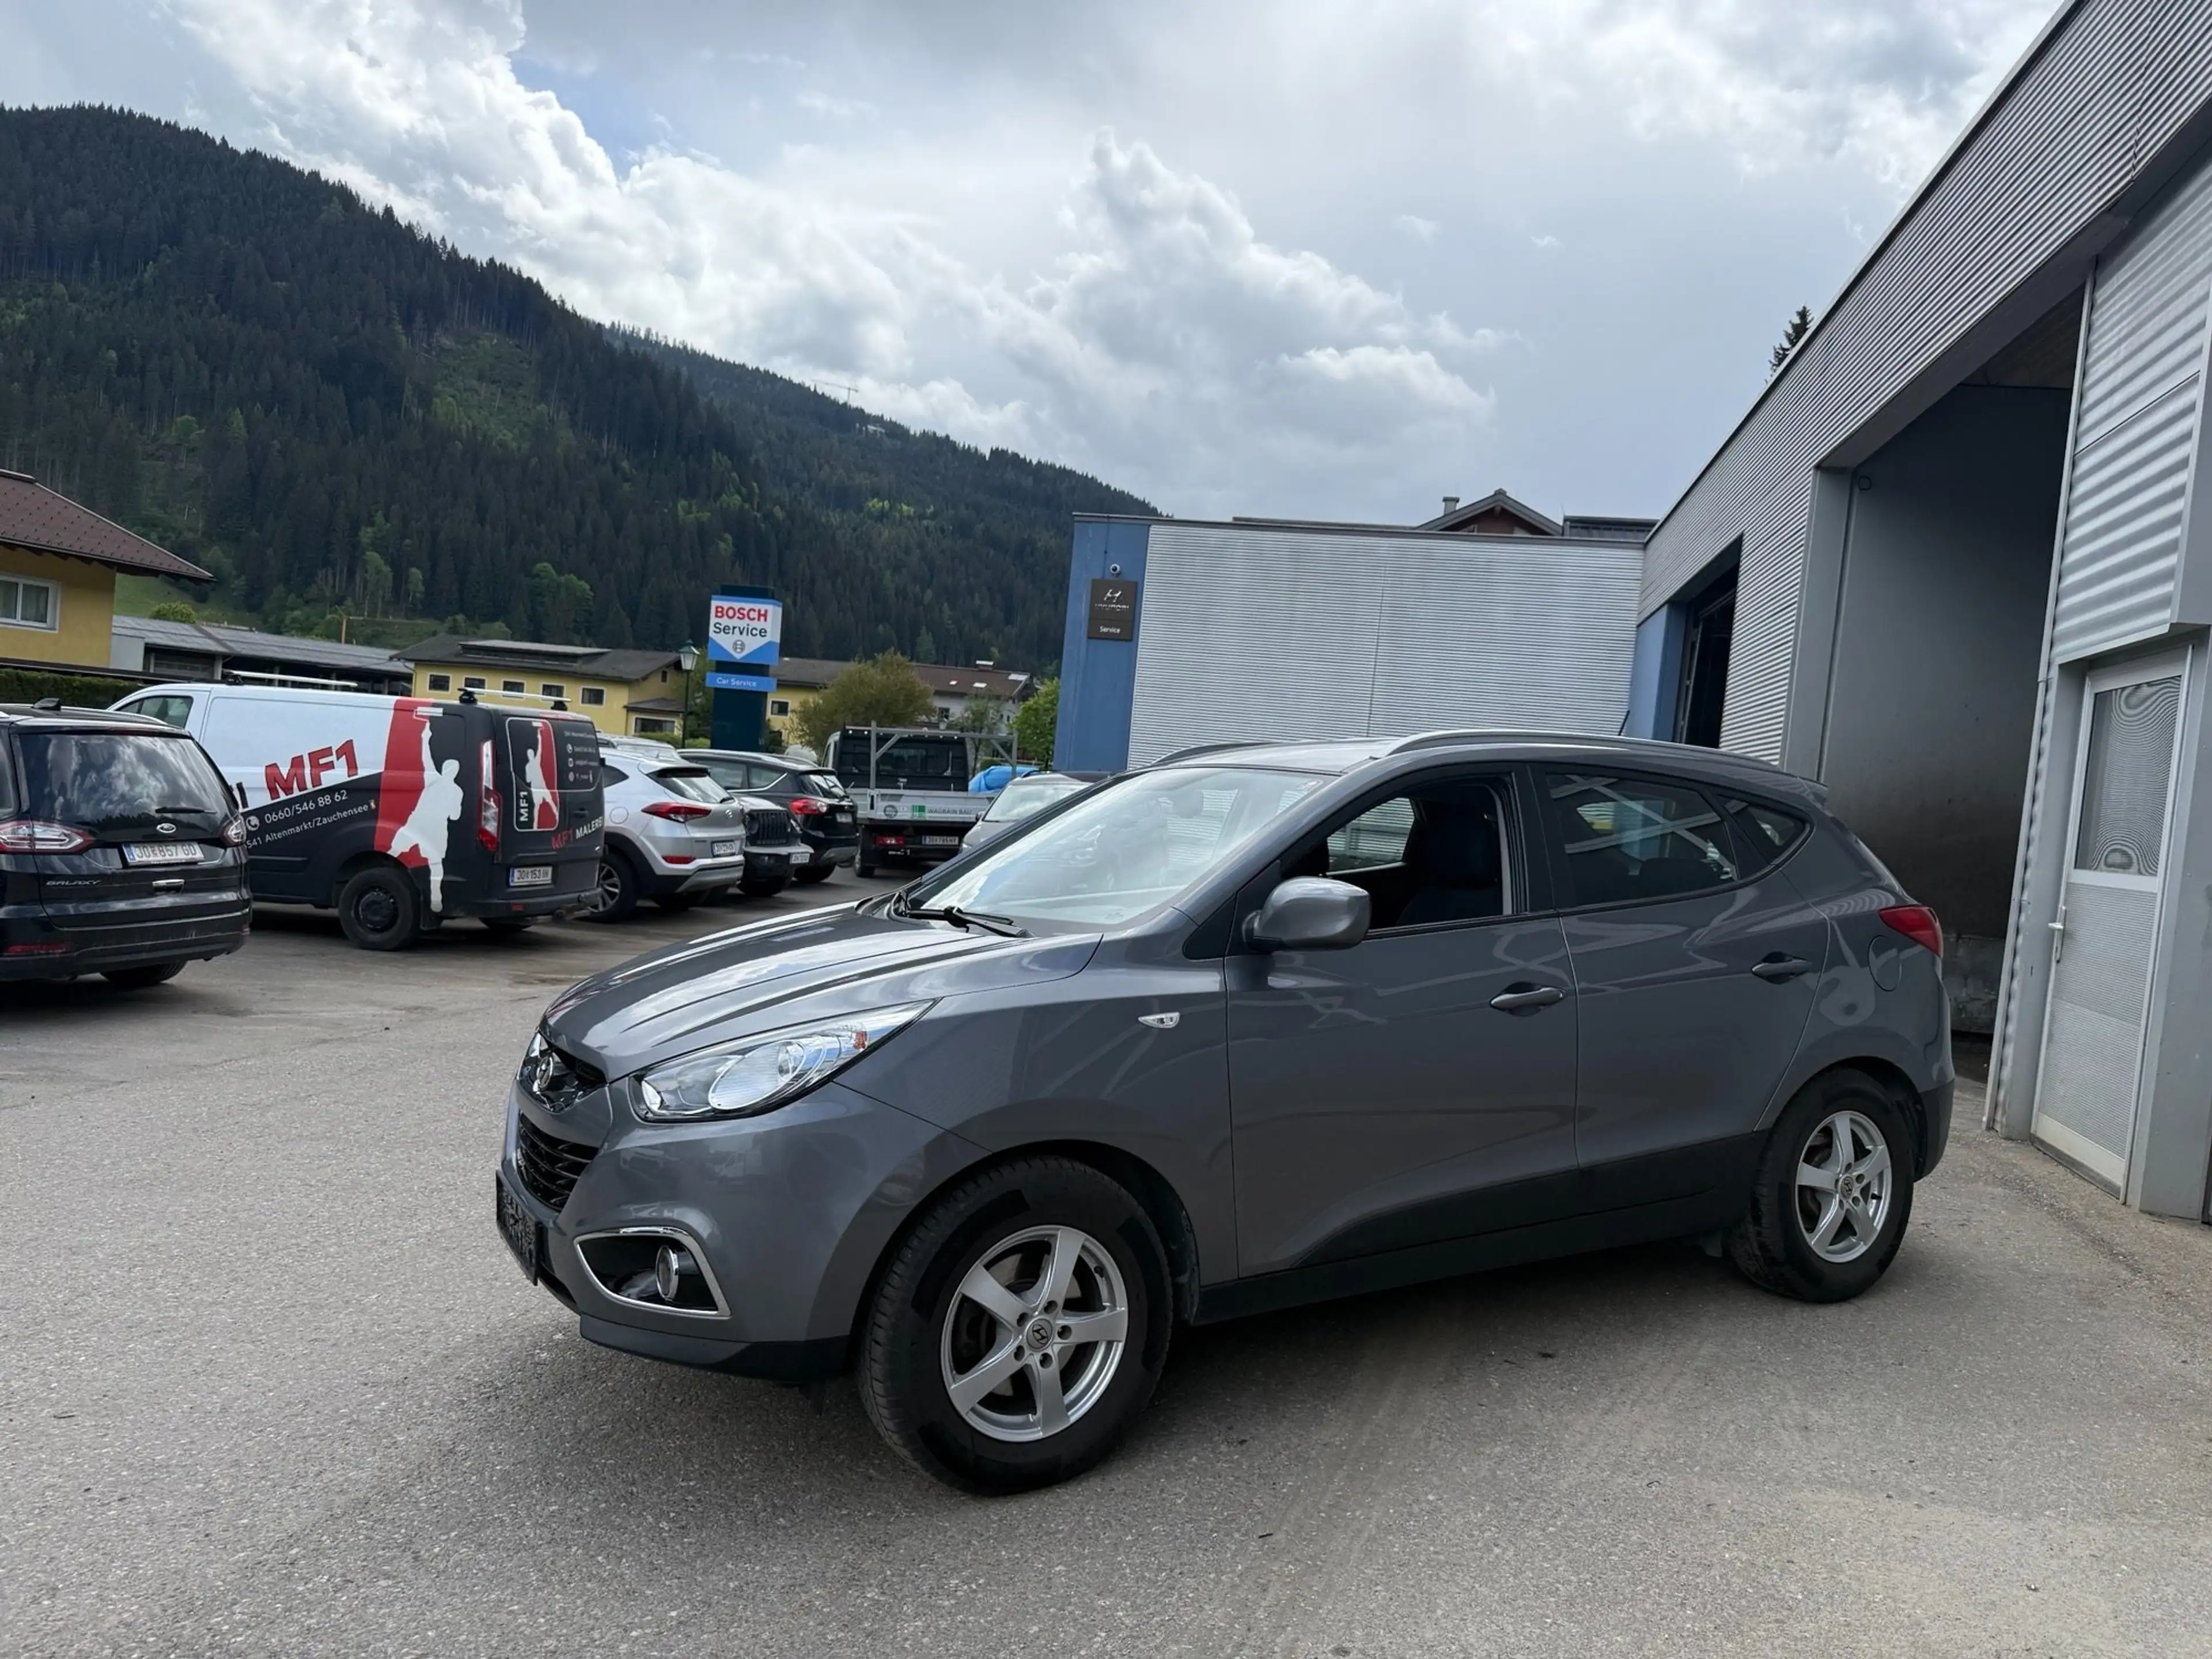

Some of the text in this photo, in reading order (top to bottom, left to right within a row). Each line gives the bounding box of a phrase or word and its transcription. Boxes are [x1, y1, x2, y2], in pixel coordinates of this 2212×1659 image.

[714, 605, 768, 622] BOSCH
[713, 622, 767, 638] Service
[1099, 626, 1120, 634] Service
[730, 678, 757, 687] Service
[264, 738, 358, 801] MF1
[264, 789, 348, 824] 0660/546 88 62
[520, 791, 528, 821] MF1
[265, 805, 369, 843] Altenmarkt/Zauchensee
[551, 828, 574, 850] MF1
[158, 844, 179, 857] 857
